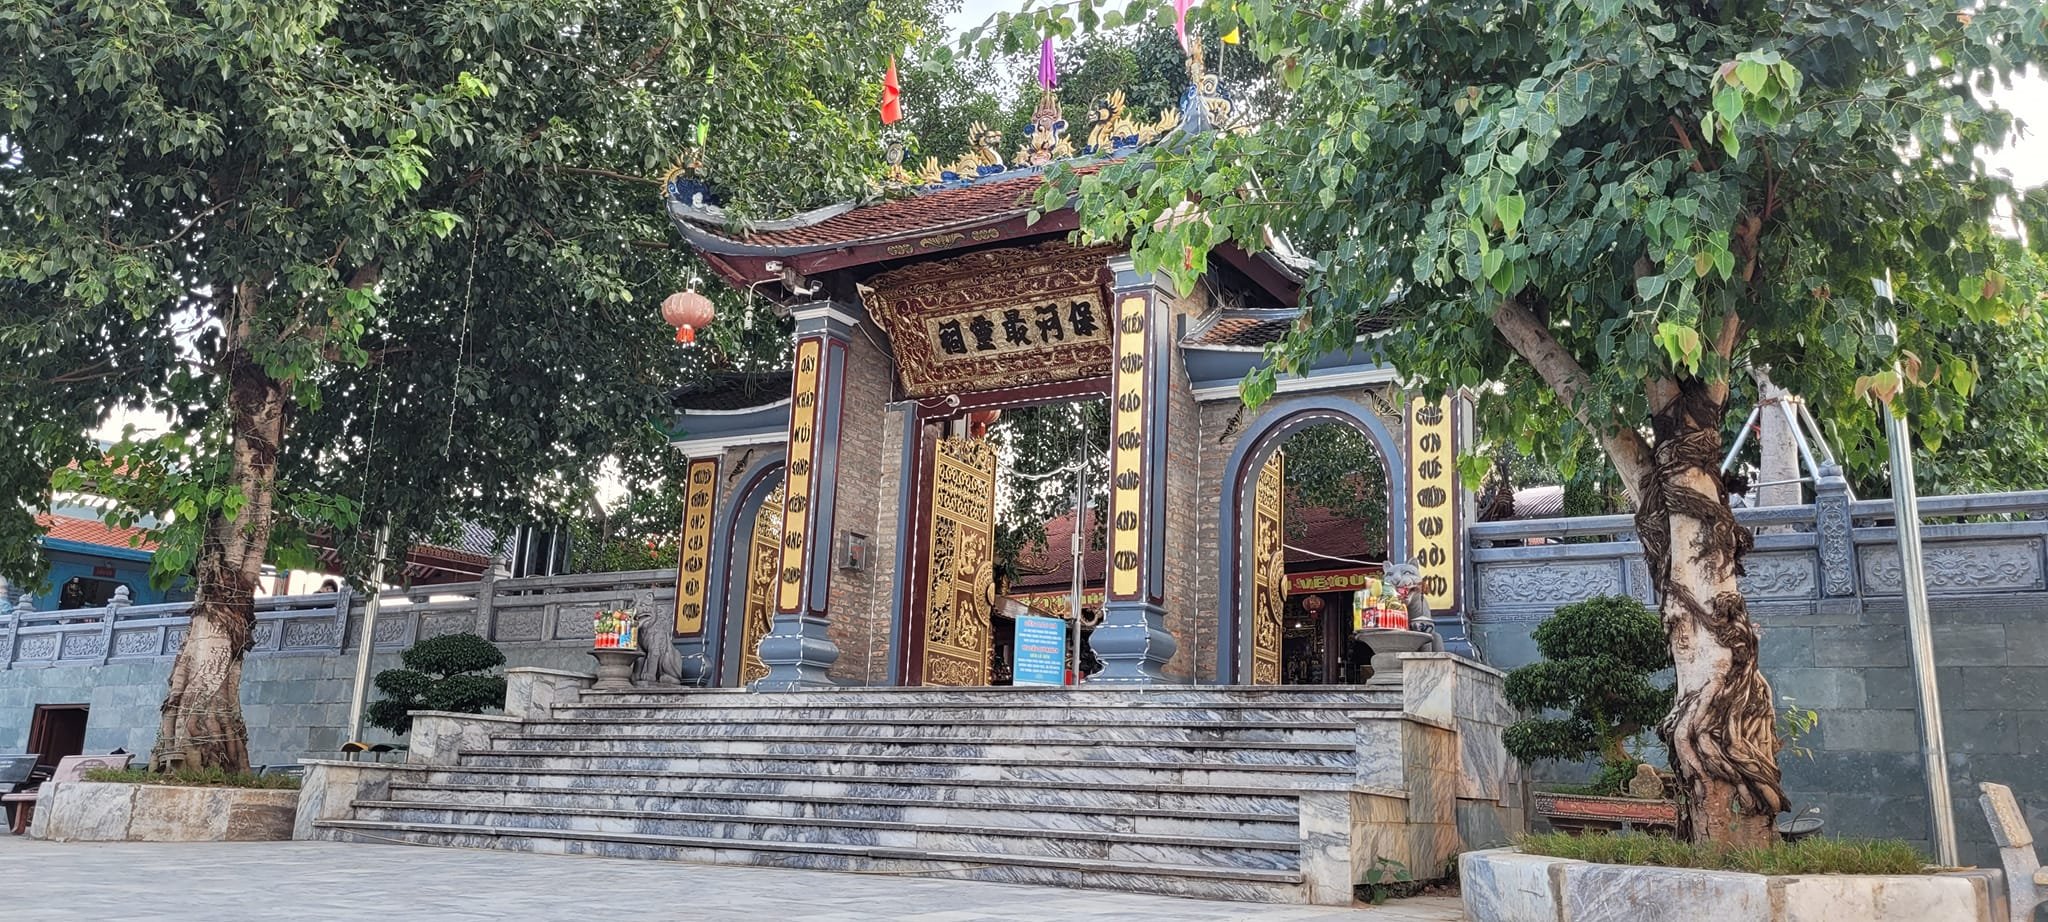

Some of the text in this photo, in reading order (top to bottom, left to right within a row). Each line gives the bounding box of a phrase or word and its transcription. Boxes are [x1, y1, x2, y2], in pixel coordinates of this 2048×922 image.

[1119, 389, 1140, 413] BÁO
[794, 422, 810, 442] NÚI
[1420, 432, 1441, 453] ƠN
[1116, 468, 1139, 490] SÁNG
[1418, 456, 1442, 480] ĐỨC
[1116, 510, 1137, 531] ANH
[1417, 516, 1443, 539] VẠN
[1417, 542, 1446, 568] ĐỜI
